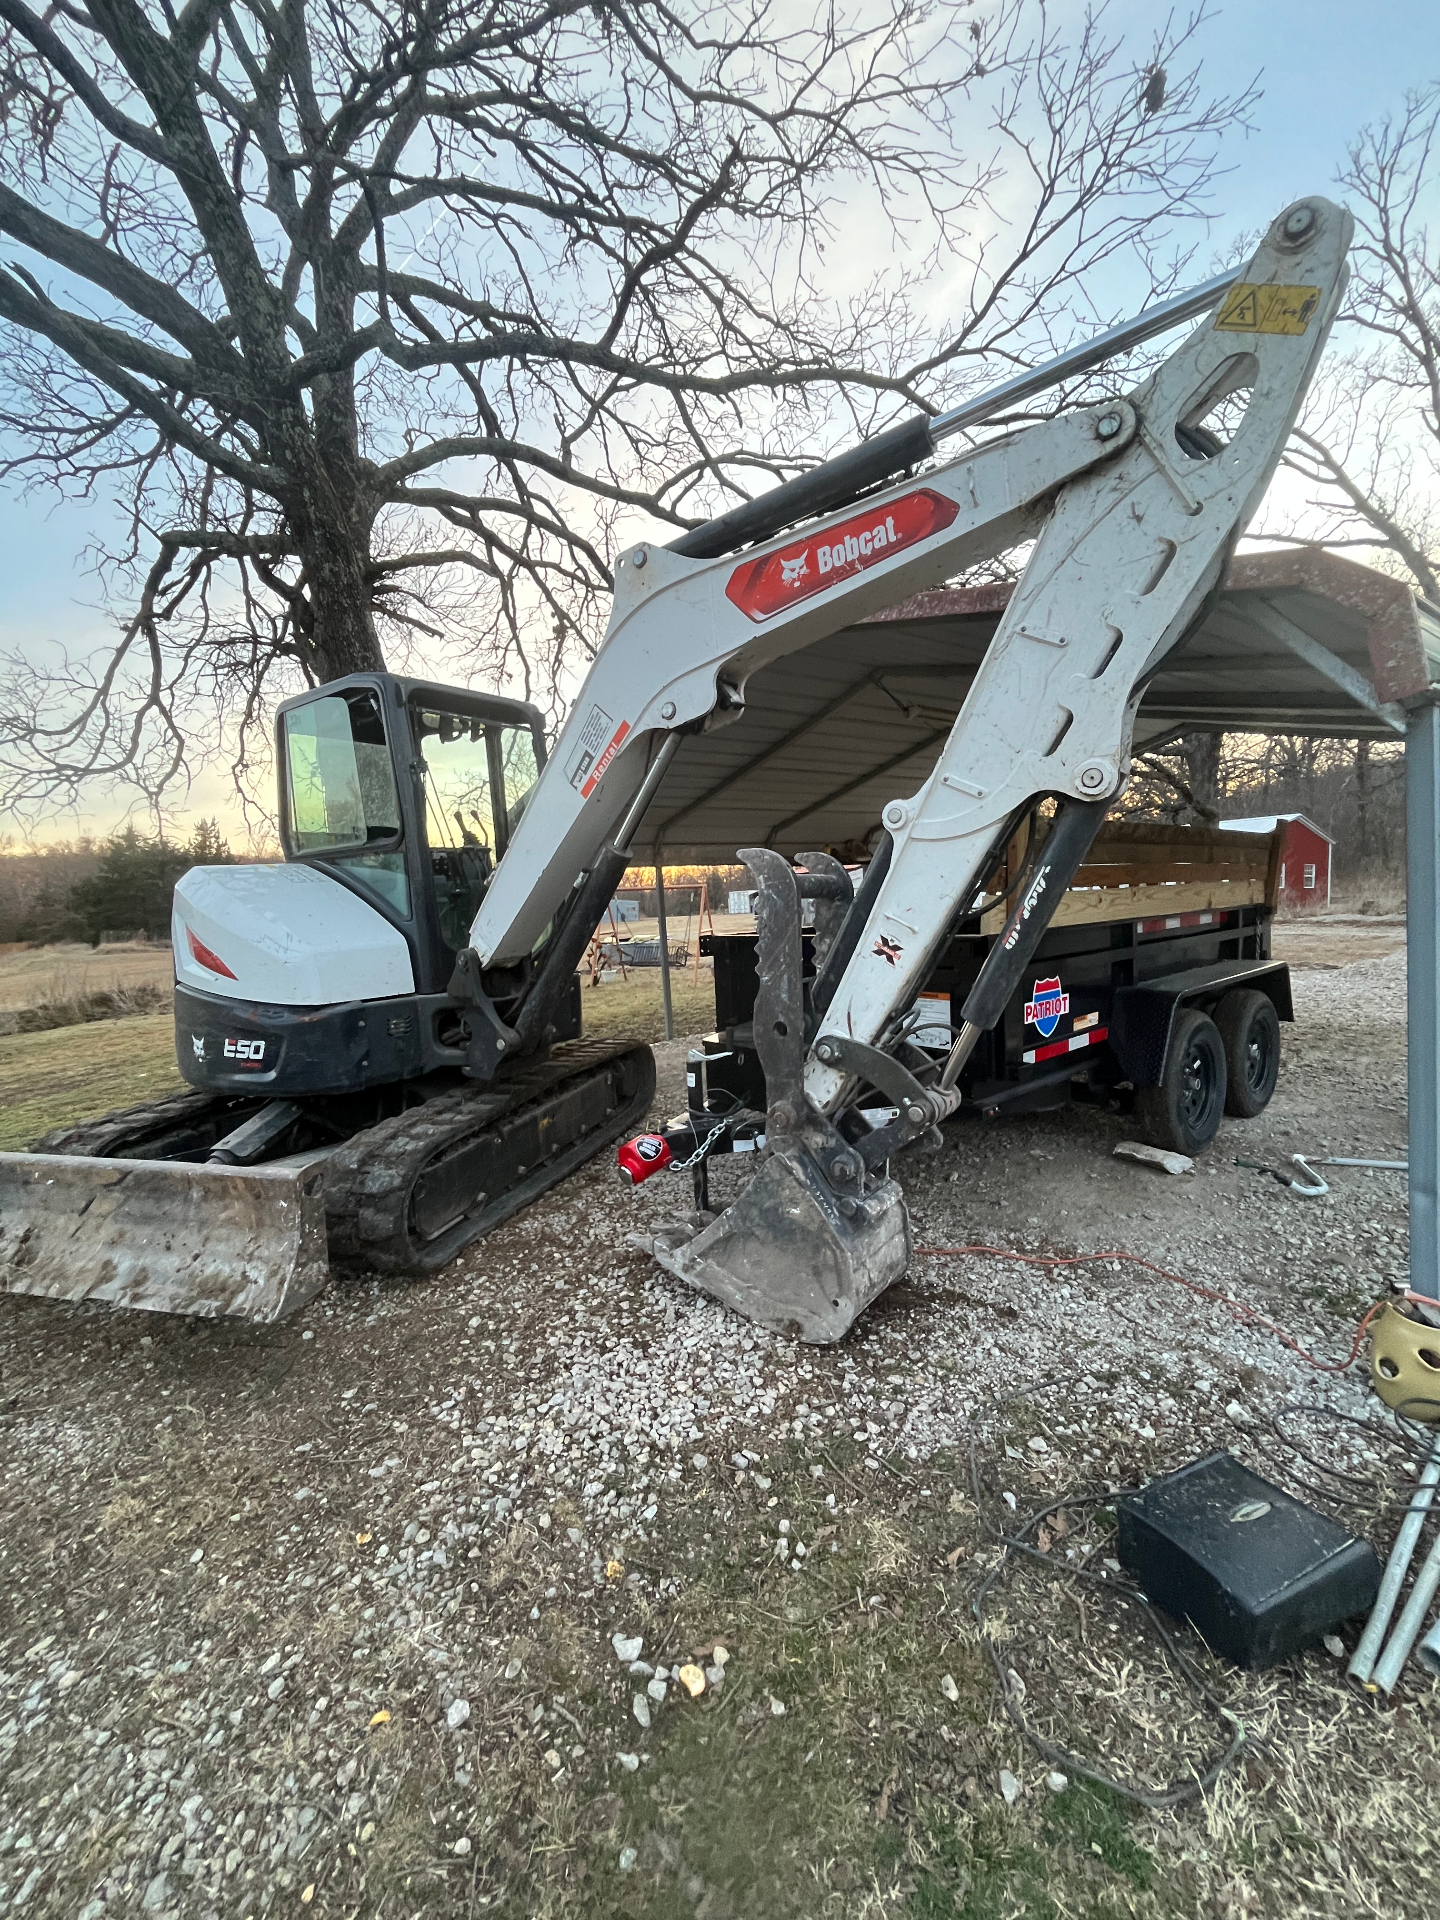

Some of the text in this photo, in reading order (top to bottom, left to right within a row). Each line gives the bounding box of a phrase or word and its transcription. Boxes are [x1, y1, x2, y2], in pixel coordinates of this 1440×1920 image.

[817, 516, 897, 575] Bobcat
[580, 756, 590, 772] STAR
[591, 740, 618, 781] Rental
[1025, 996, 1067, 1022] PATRIOT
[224, 1038, 265, 1060] E50
